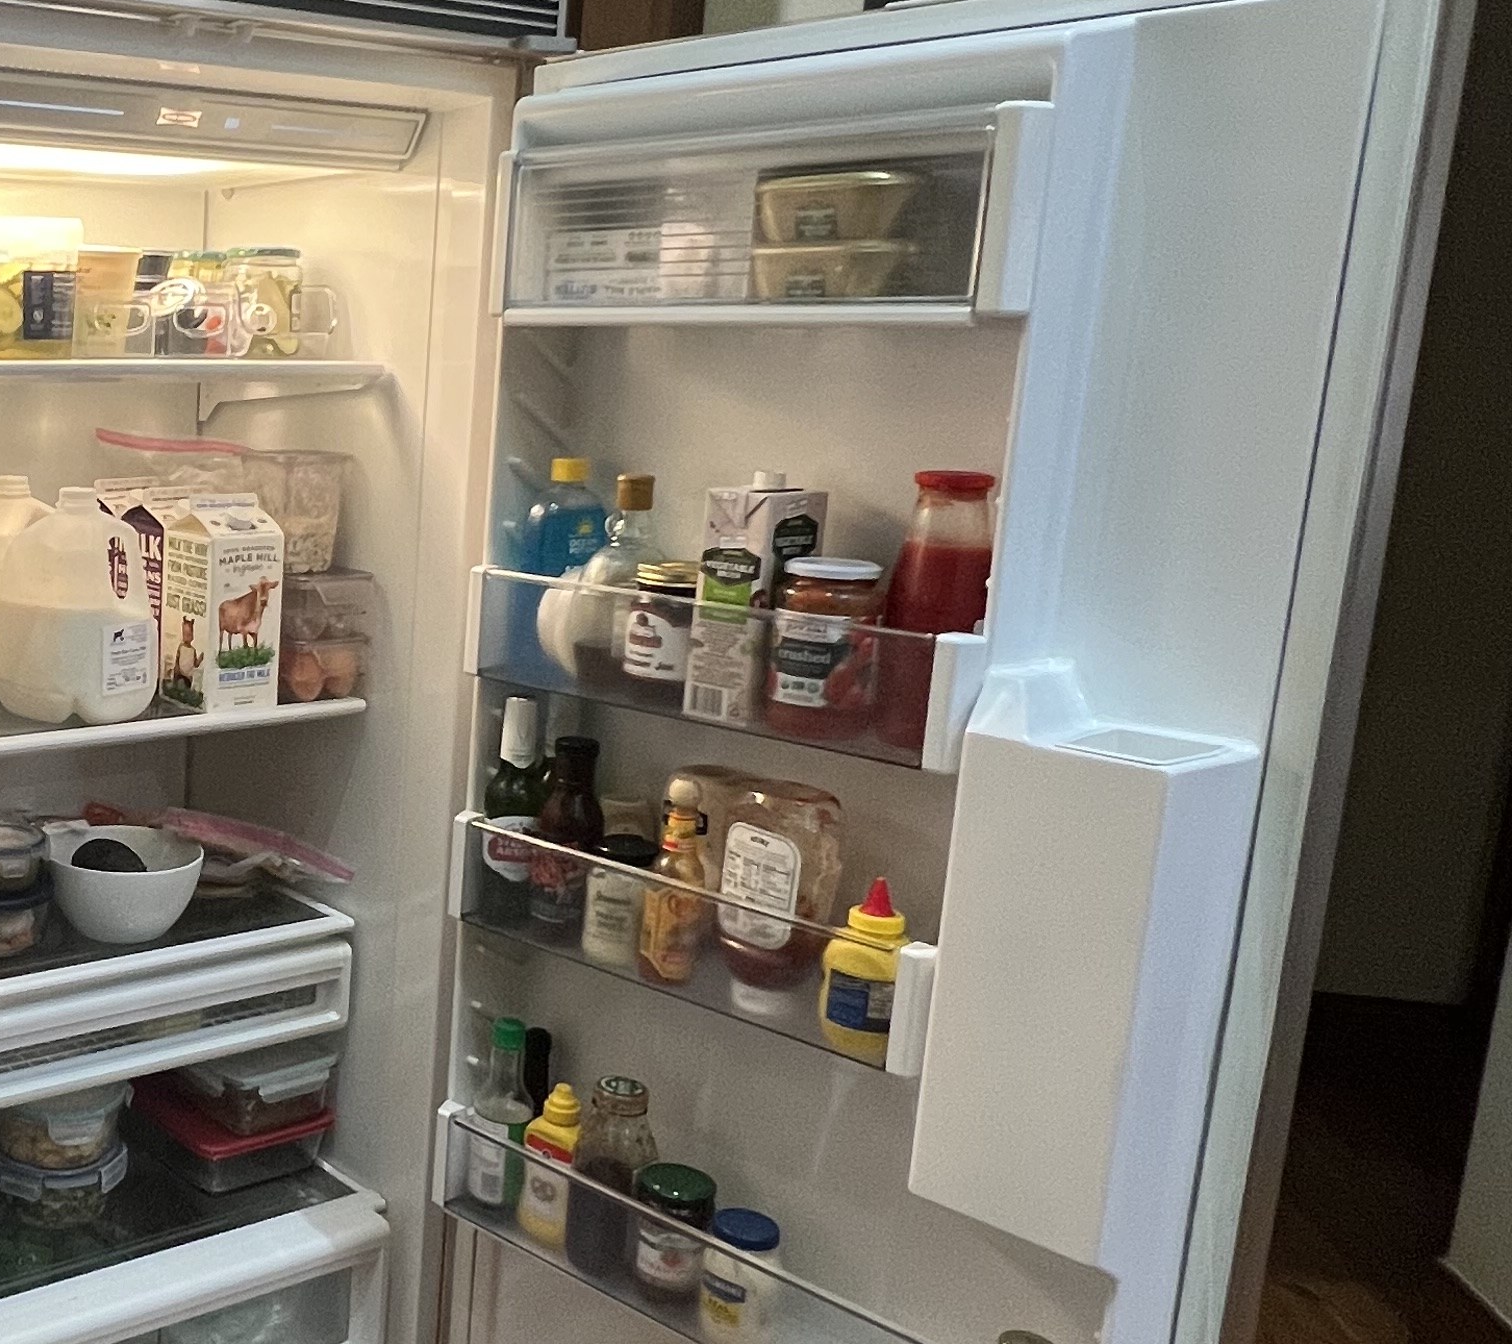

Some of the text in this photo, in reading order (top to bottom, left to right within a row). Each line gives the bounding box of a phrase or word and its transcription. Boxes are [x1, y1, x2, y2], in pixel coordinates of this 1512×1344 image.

[219, 553, 253, 566] MAPLE
[256, 553, 278, 563] HILL
[705, 560, 756, 575] VEGETABLE
